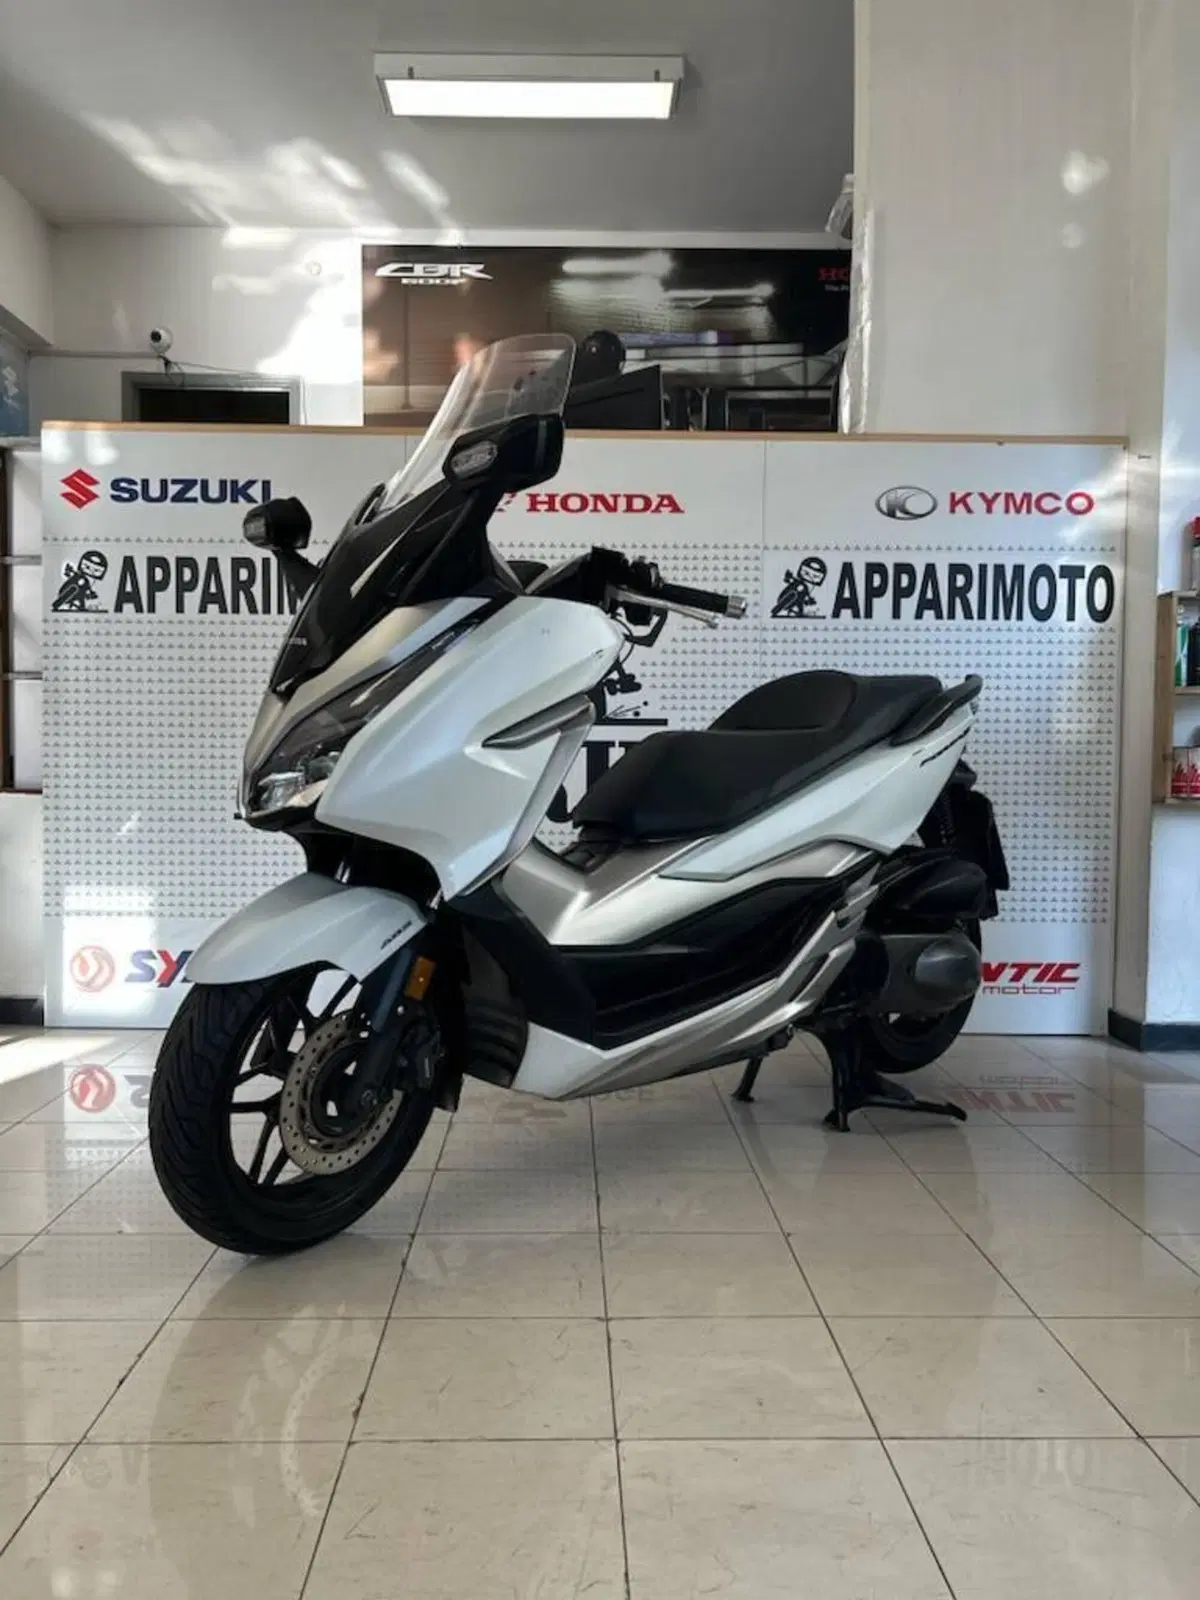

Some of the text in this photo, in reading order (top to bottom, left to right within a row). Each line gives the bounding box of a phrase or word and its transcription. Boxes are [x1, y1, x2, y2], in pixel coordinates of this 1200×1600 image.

[375, 263, 494, 280] CBR
[110, 477, 271, 504] SUZUKI
[526, 493, 685, 513] HONDA
[949, 491, 1095, 516] KYMCO
[831, 562, 1115, 623] APPARIMOTO
[124, 949, 194, 988] SY
[981, 984, 1076, 995] motor
